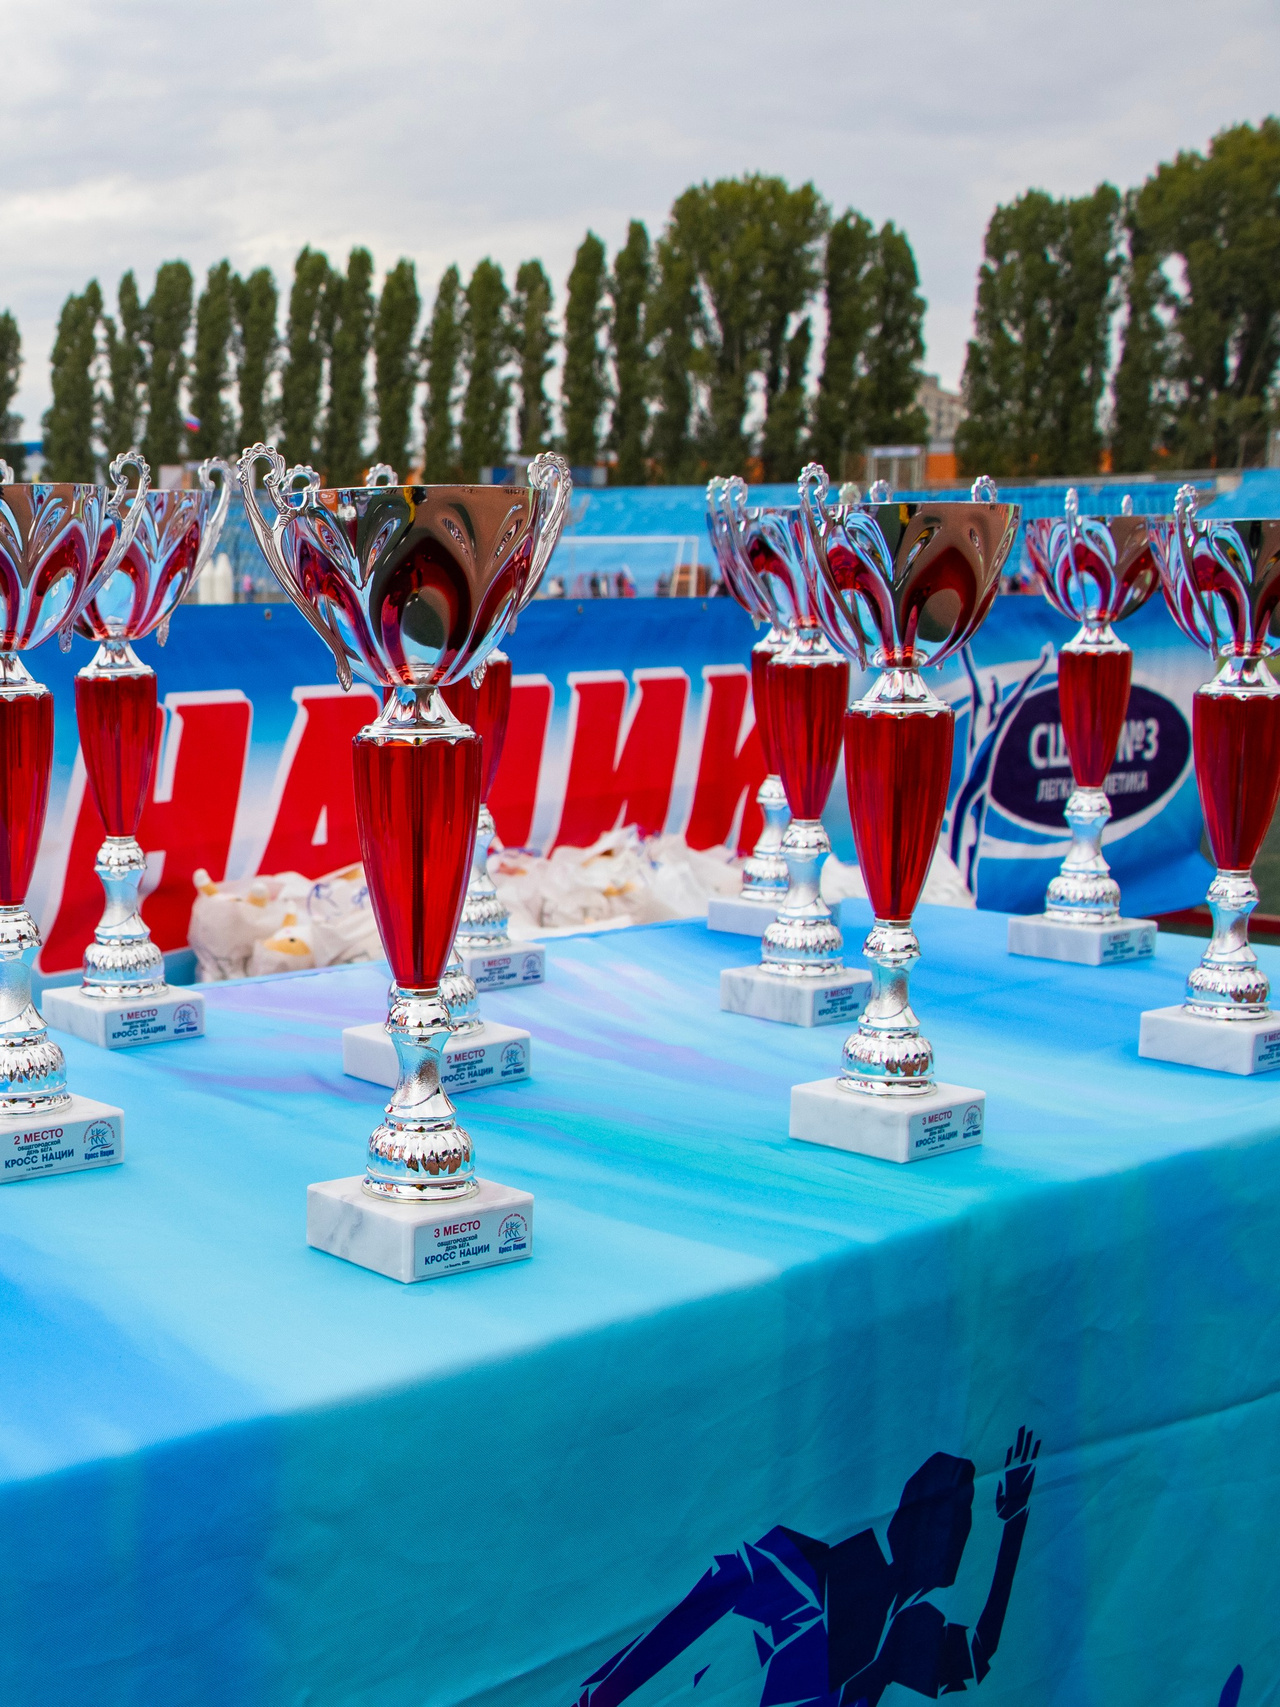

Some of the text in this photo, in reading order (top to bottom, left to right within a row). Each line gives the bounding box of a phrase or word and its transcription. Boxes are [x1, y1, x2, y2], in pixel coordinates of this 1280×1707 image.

[127, 1008, 158, 1020] МЕСТО
[112, 1027, 138, 1039] КРОСС
[454, 1049, 485, 1062] МЕСТО
[928, 1110, 953, 1124] МЕСТО
[14, 1128, 64, 1145] 2 МЕСТО
[916, 1136, 937, 1148] КРОСС
[5, 1155, 38, 1169] КРОСС
[42, 1148, 74, 1162] НАЦИИ
[434, 1220, 480, 1238] 3 МЕСТО
[425, 1251, 456, 1265] КРОСС
[459, 1244, 490, 1258] НАЦИИ
